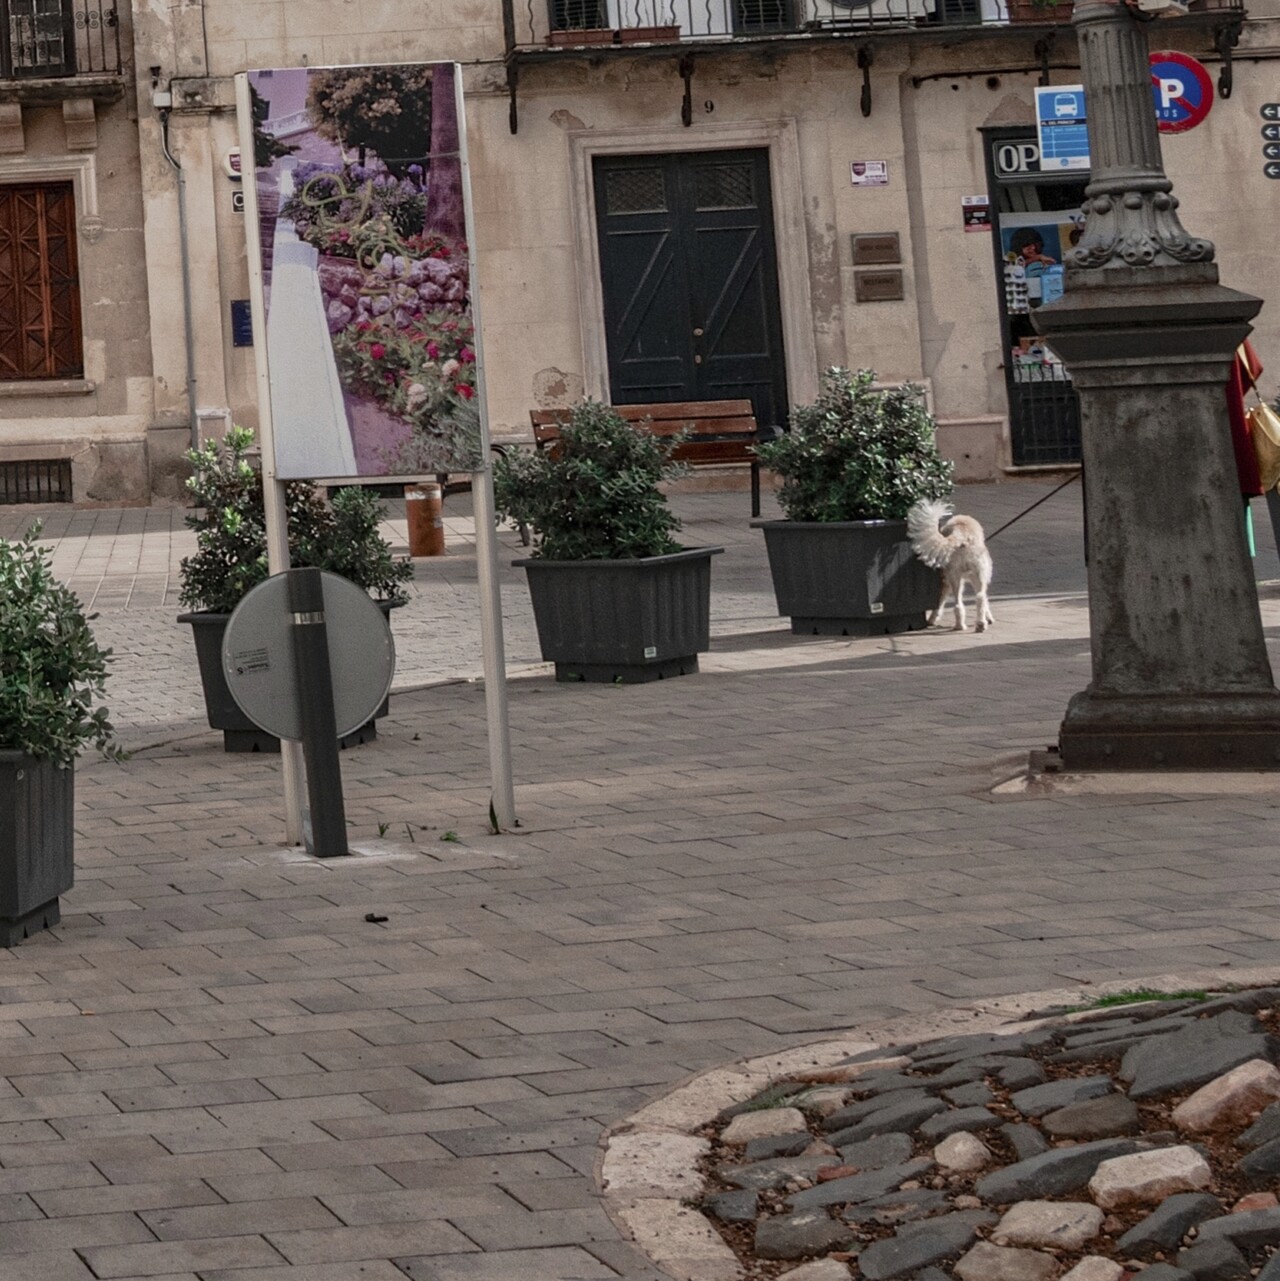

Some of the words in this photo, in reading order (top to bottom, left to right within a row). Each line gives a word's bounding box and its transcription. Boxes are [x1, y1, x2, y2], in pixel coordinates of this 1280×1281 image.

[704, 100, 714, 114] 9
[1159, 78, 1184, 108] P
[998, 144, 1040, 172] OP
